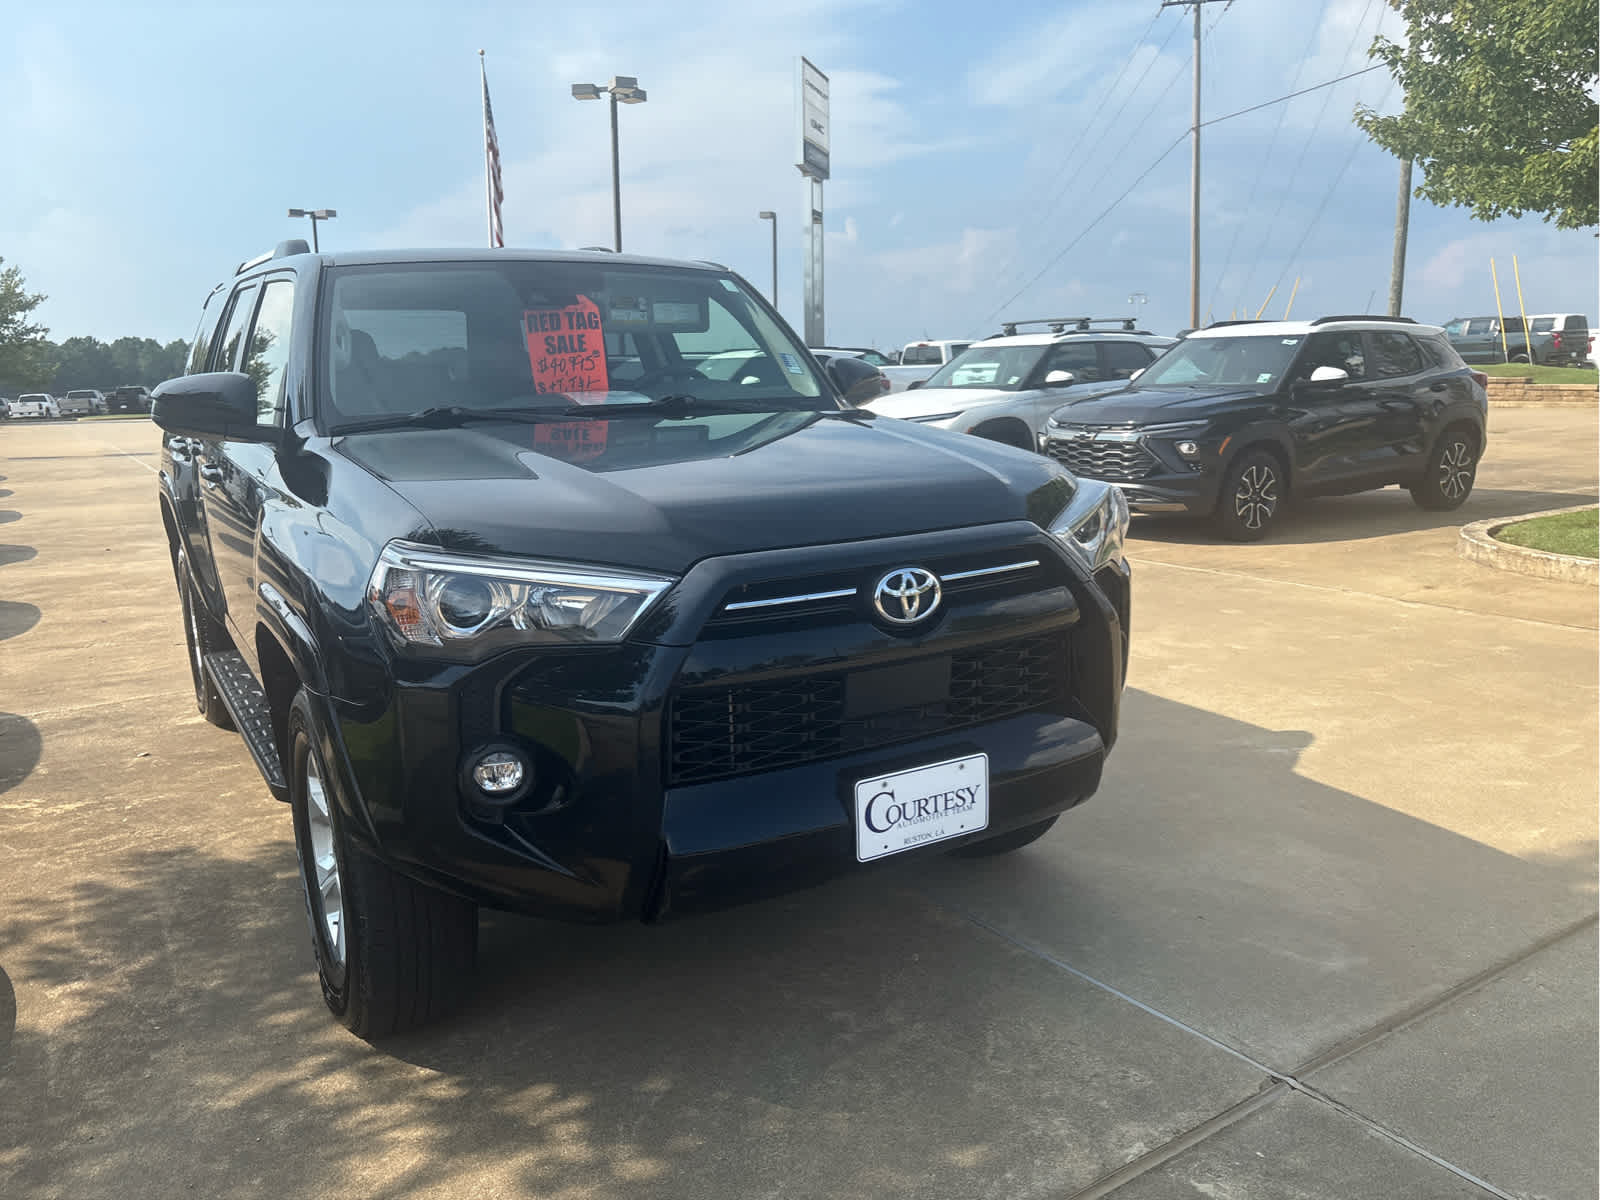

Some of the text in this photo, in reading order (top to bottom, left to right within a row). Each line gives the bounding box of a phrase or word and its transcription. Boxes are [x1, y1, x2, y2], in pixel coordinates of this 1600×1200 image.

[527, 312, 561, 333] RED
[564, 311, 600, 331] TAG
[544, 334, 587, 355] SALE
[897, 803, 973, 829] AUTOMOTIVE TEAM
[934, 828, 946, 839] LA
